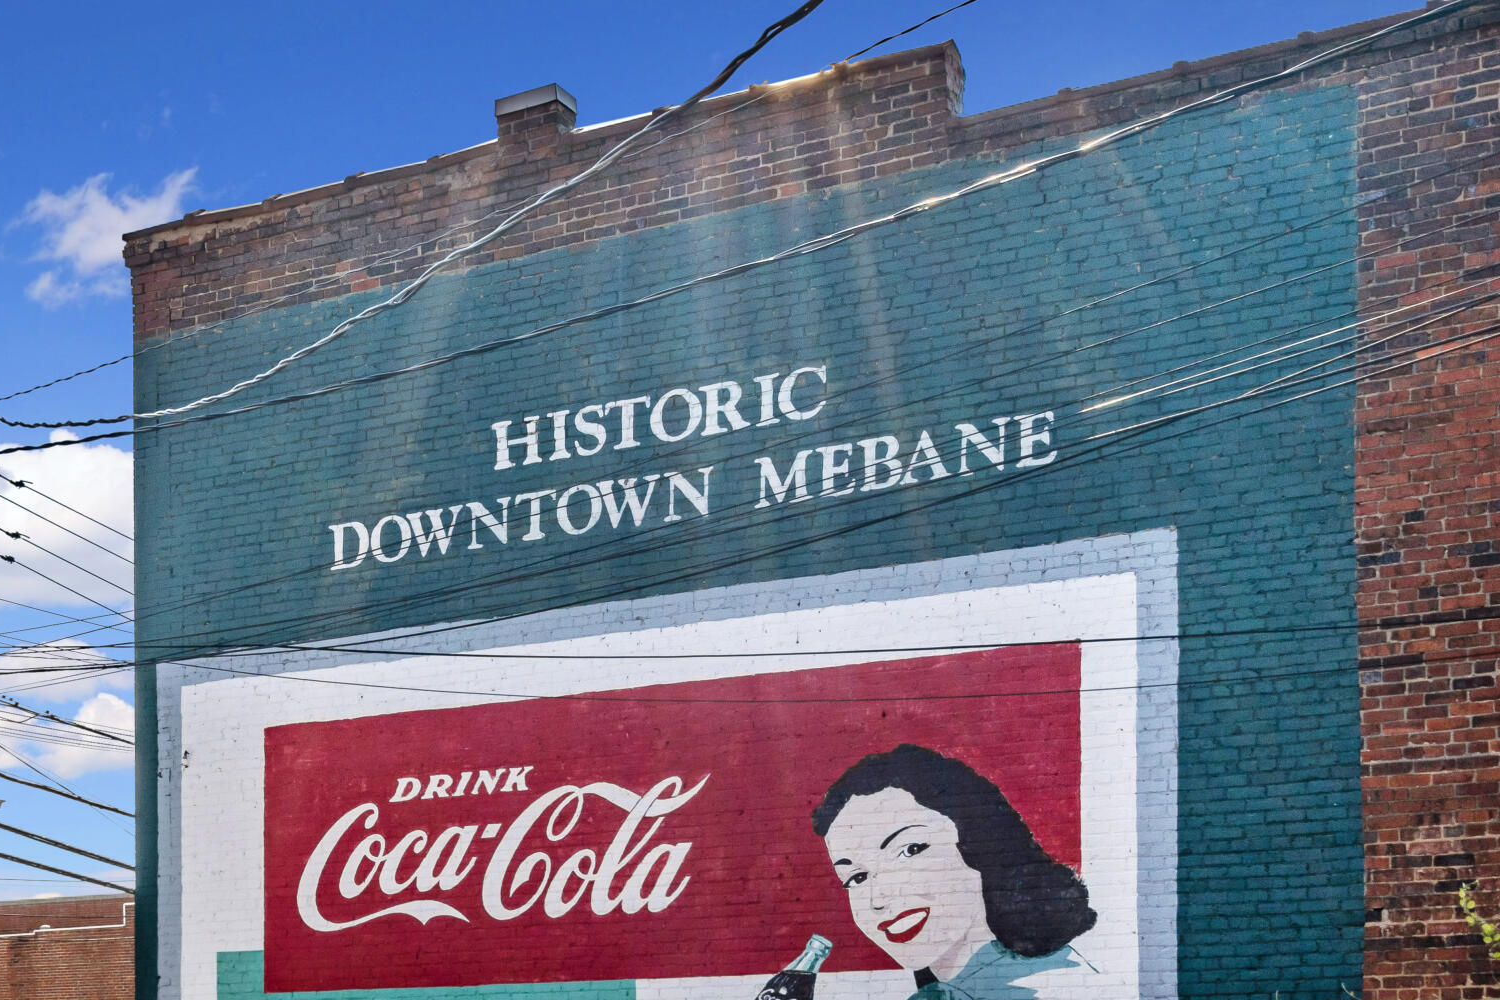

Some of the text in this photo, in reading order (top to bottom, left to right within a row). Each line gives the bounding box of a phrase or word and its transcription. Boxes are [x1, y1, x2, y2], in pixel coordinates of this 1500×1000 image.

[491, 365, 828, 470] HISTORIC
[329, 409, 1058, 571] DOWNTOWN MEBANE
[389, 766, 534, 803] DRINK
[296, 773, 711, 932] Coca-Cola
